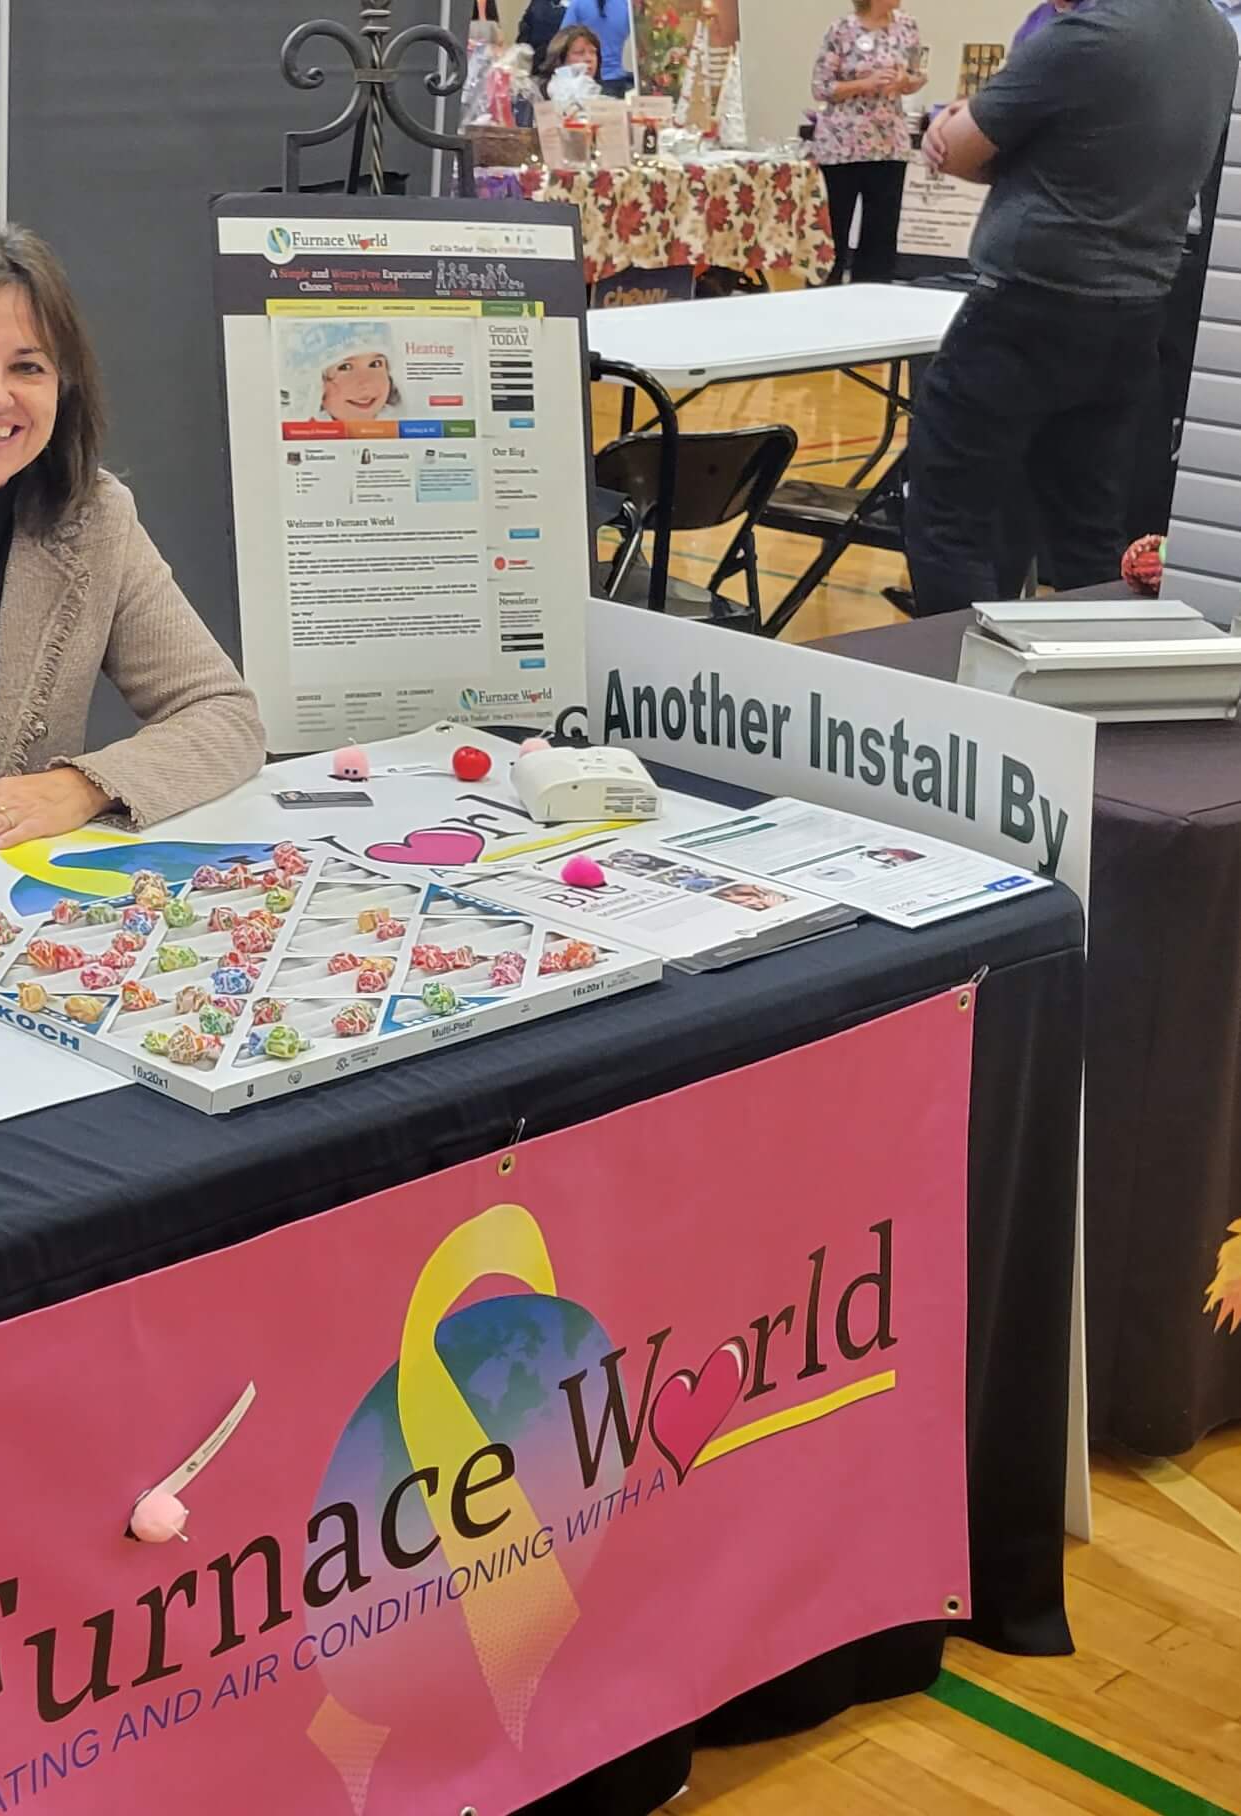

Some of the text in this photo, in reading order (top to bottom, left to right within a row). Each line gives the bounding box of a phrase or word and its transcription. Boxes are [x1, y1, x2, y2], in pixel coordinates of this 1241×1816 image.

[291, 231, 345, 248] Furnace
[311, 269, 329, 279] and
[489, 334, 529, 346] TODAY
[405, 342, 455, 357] Heating
[286, 519, 324, 528] Welcome
[336, 518, 368, 527] Furnace
[369, 516, 395, 526] World
[479, 690, 519, 703] Furnace
[604, 669, 1068, 880] Another Install By
[571, 979, 606, 998] 16x20x1
[131, 1063, 169, 1090] 16x20x1
[112, 1687, 202, 1753] AND
[212, 1654, 280, 1710] AIR
[293, 1526, 555, 1673] CONDITIONING
[565, 1486, 642, 1543] WITH
[646, 1467, 666, 1501] A
